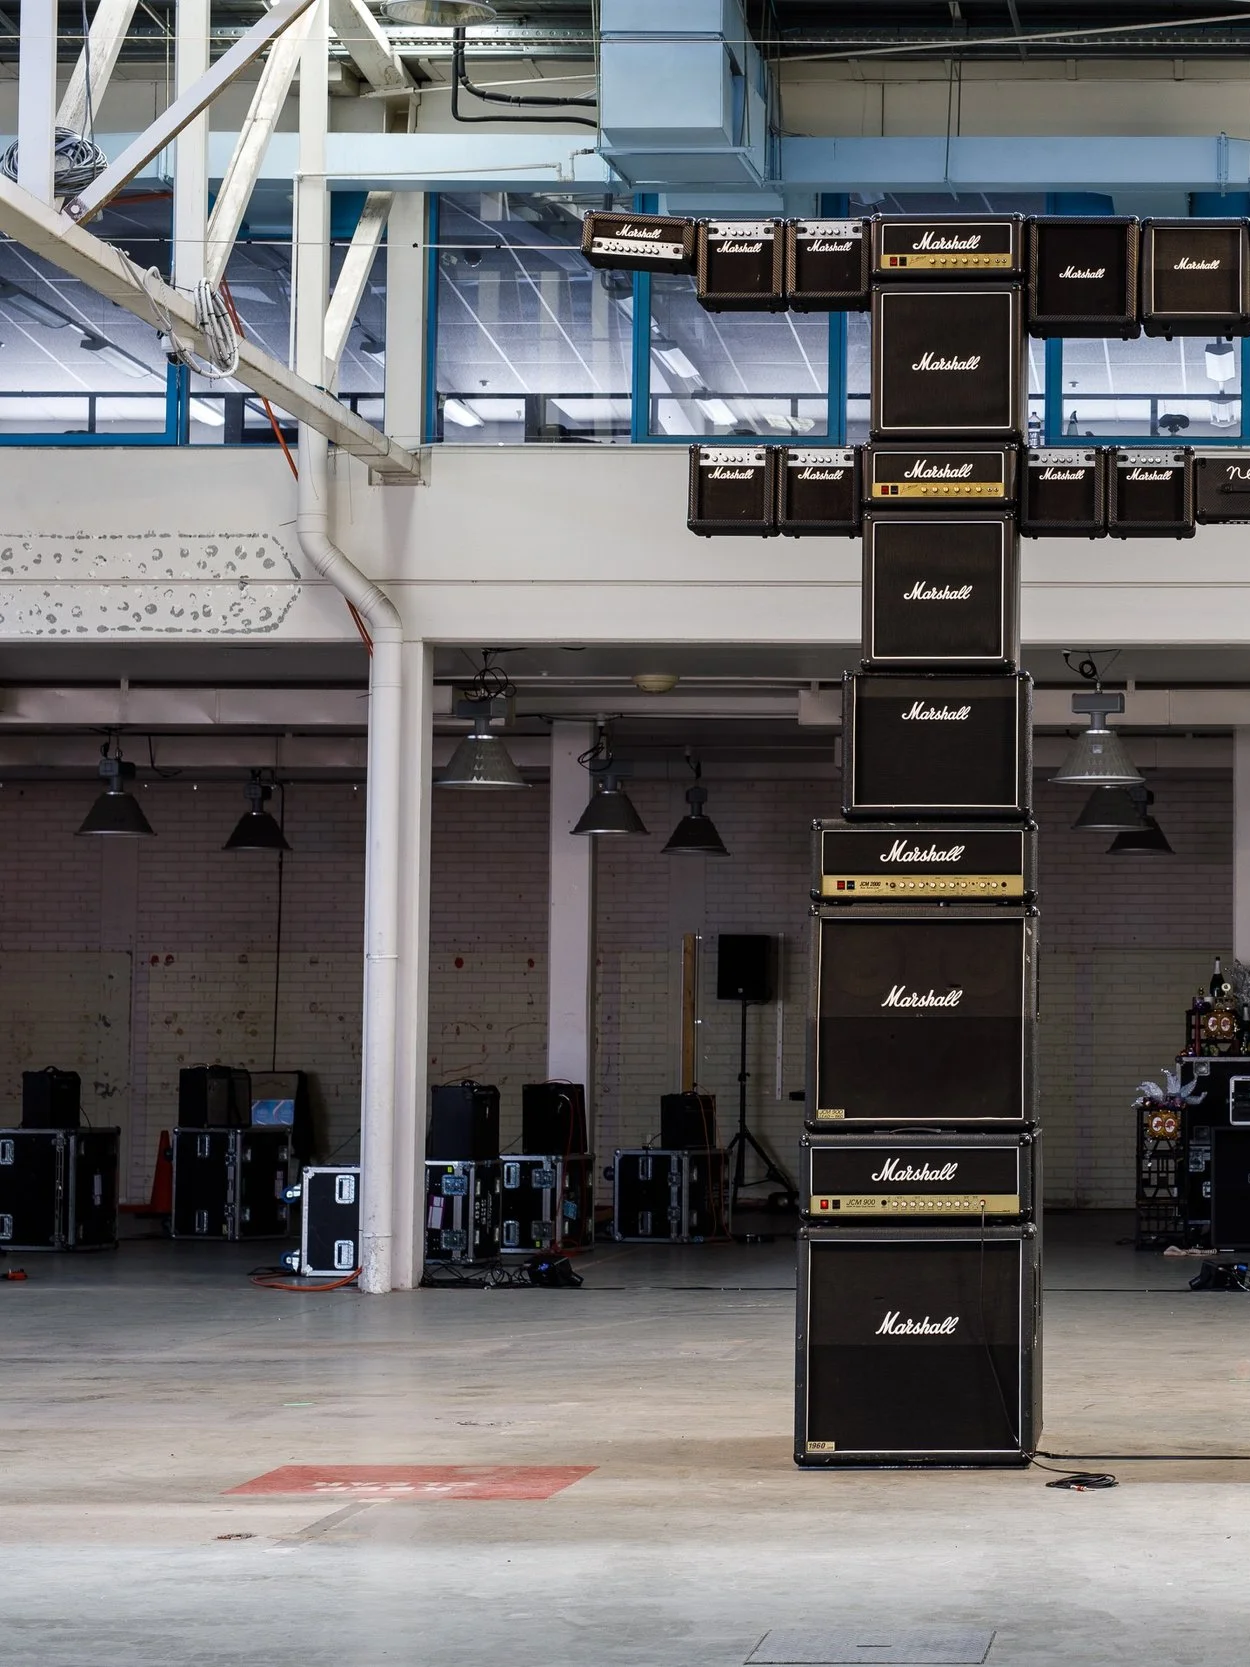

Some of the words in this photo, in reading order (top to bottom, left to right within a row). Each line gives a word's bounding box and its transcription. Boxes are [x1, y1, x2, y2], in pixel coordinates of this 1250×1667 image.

[616, 224, 662, 239] Marshall
[716, 241, 763, 253] Marshall
[806, 240, 853, 252] Marshall
[912, 231, 982, 250] Marshall
[1058, 266, 1106, 279] Marshall
[1173, 258, 1221, 270] Marshall
[911, 351, 981, 371] Marshall
[708, 466, 753, 479] Marshall
[797, 467, 843, 480] Marshall
[903, 459, 974, 479] Marshall
[1038, 468, 1086, 481] Marshall
[1126, 468, 1173, 481] Marshall
[903, 580, 973, 600] Marshall
[901, 701, 972, 721] Marshall
[879, 839, 966, 863] Marshall
[881, 984, 963, 1008] Marshall
[871, 1157, 959, 1182] Marshall
[875, 1310, 960, 1335] Marshall
